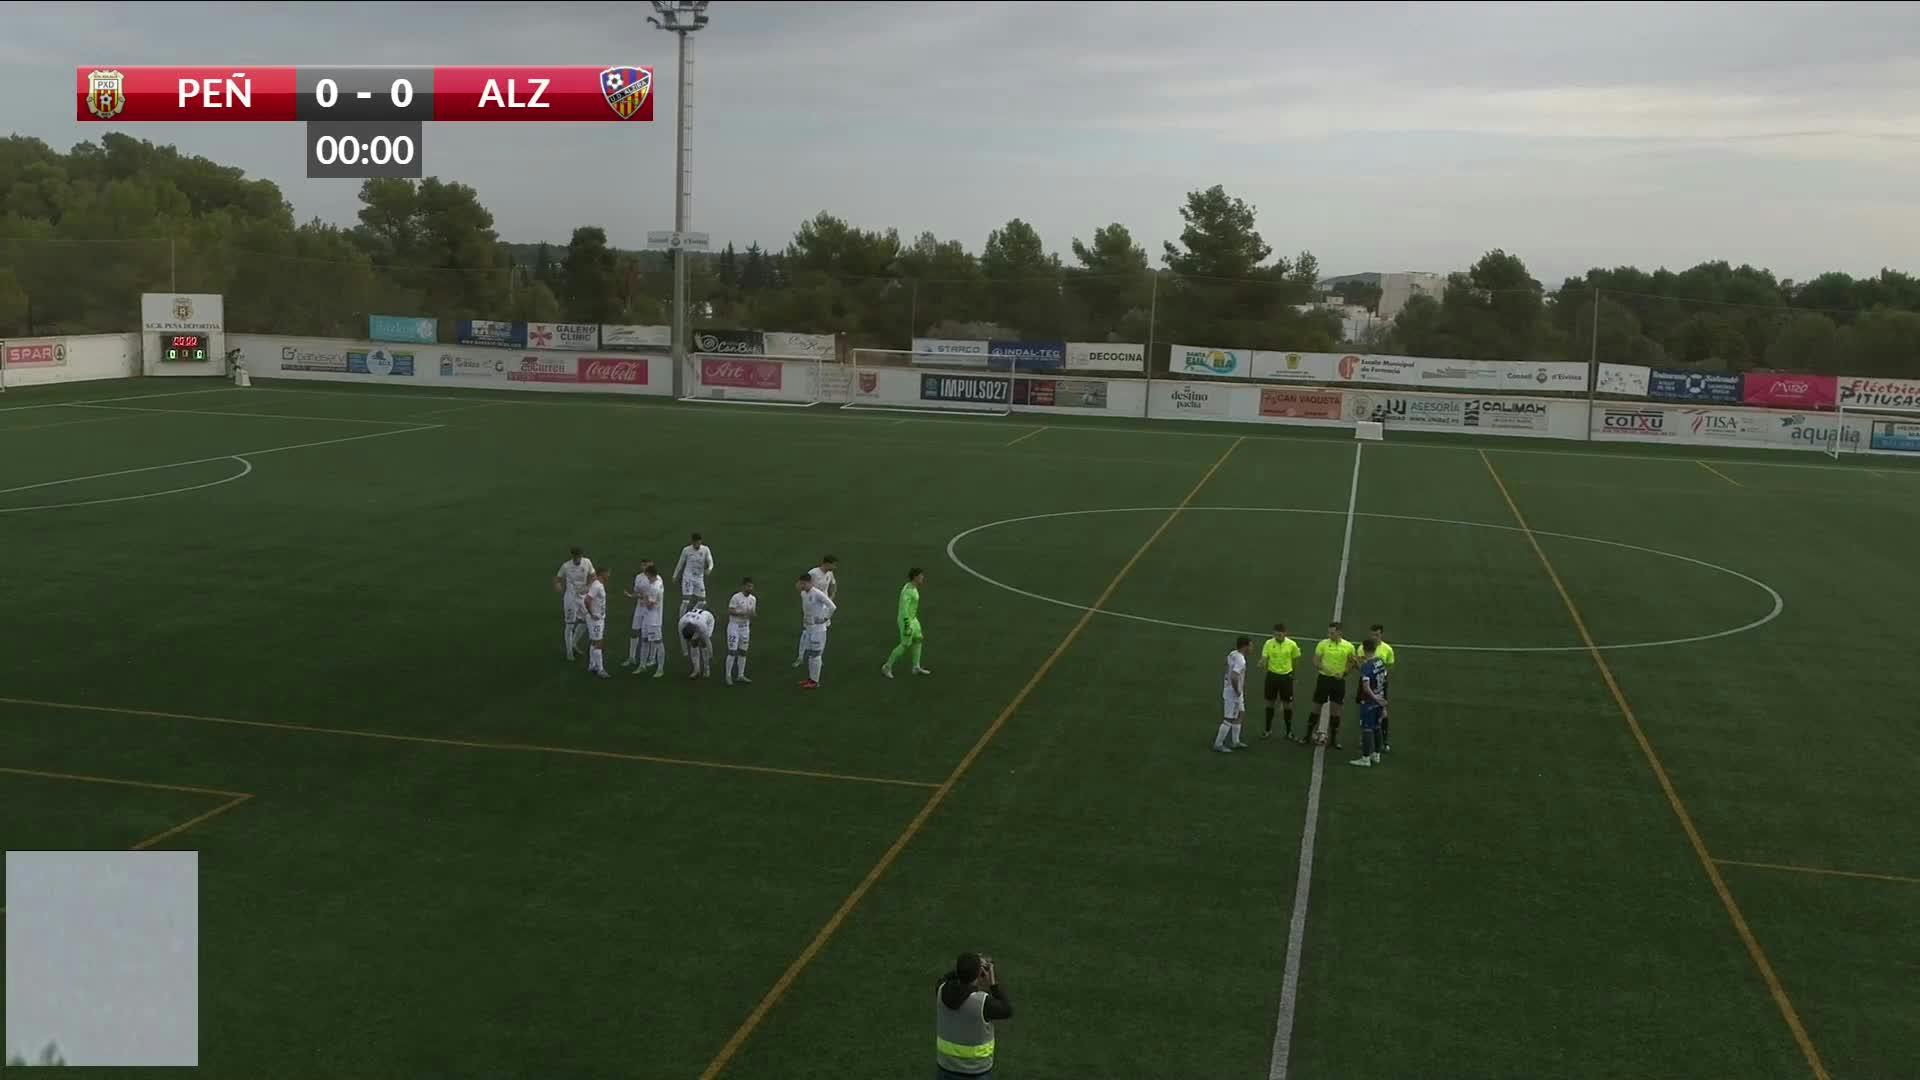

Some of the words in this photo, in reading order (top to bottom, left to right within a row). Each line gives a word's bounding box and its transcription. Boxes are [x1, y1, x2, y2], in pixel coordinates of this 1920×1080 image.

[556, 325, 596, 333] GALENO
[10, 347, 52, 361] SPAR
[1089, 352, 1143, 361] DECOCINA
[1383, 360, 1415, 368] Municipal
[1507, 372, 1533, 380] Consell
[940, 379, 1008, 400] IMPULSO27
[1171, 391, 1208, 401] destino
[1482, 401, 1546, 413] CALIMAX
[1705, 416, 1737, 428] TISA
[1792, 425, 1861, 445] aqualia
